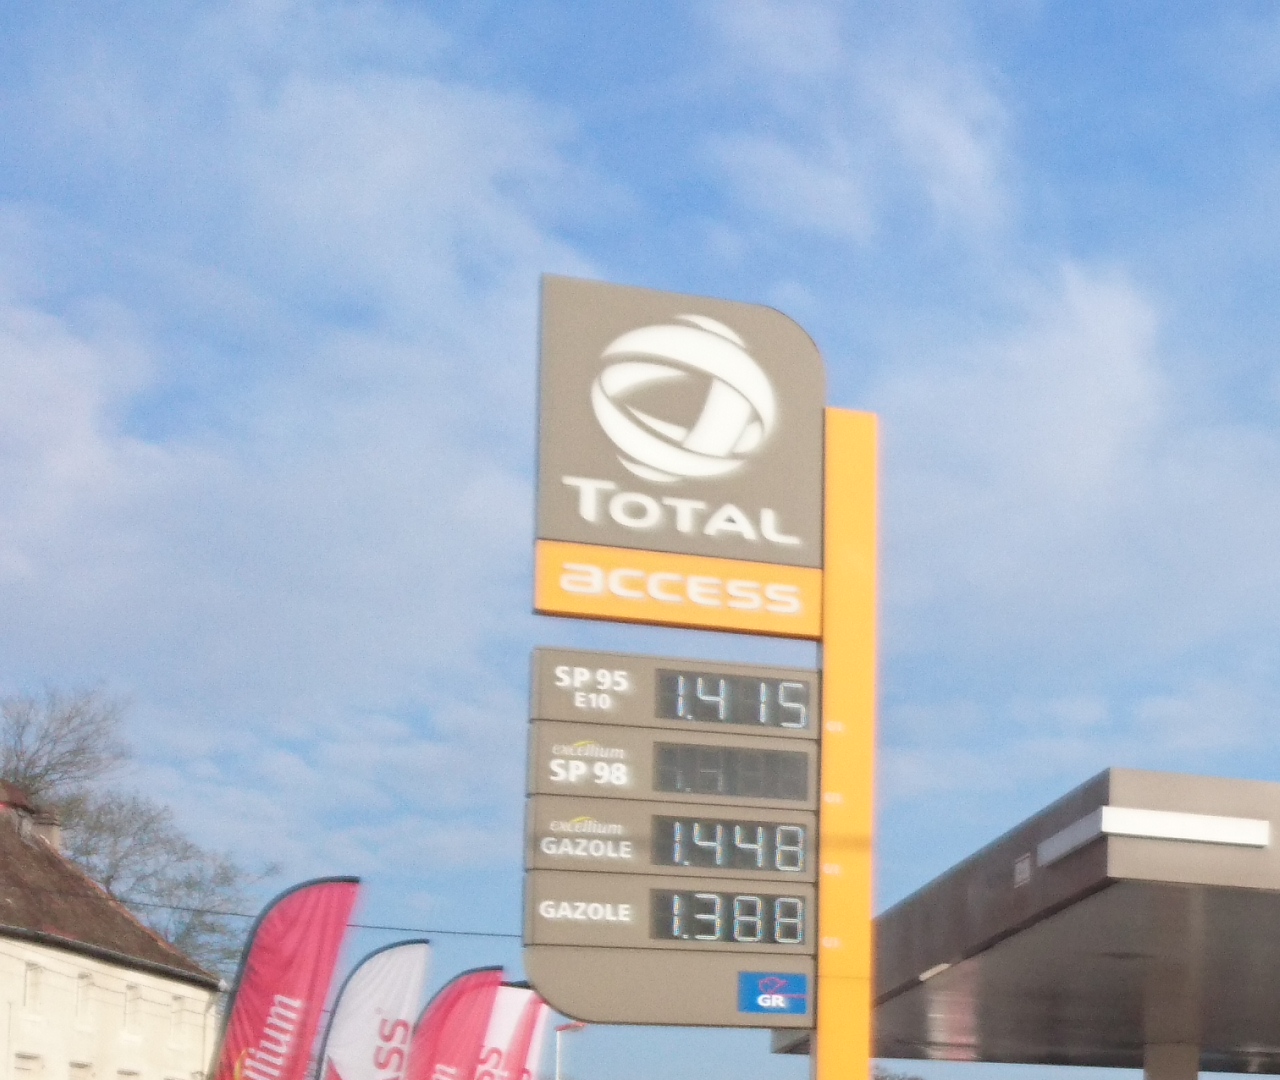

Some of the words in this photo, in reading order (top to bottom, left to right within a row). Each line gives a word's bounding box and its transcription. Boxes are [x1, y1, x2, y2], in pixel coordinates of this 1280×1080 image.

[561, 474, 803, 545] TOTAL
[558, 561, 803, 614] access
[554, 665, 590, 688] SP
[596, 669, 629, 692] 95
[574, 692, 612, 710] E10
[676, 675, 807, 729] 1.415
[551, 743, 625, 760] excellium
[549, 759, 587, 782] SP
[593, 762, 628, 786] 98
[549, 820, 624, 836] excellium
[539, 836, 633, 859] GAZOLE
[673, 821, 805, 872] 1.448
[538, 900, 632, 922] GAZOLE
[671, 892, 804, 944] 1.388
[756, 993, 786, 1008] GR
